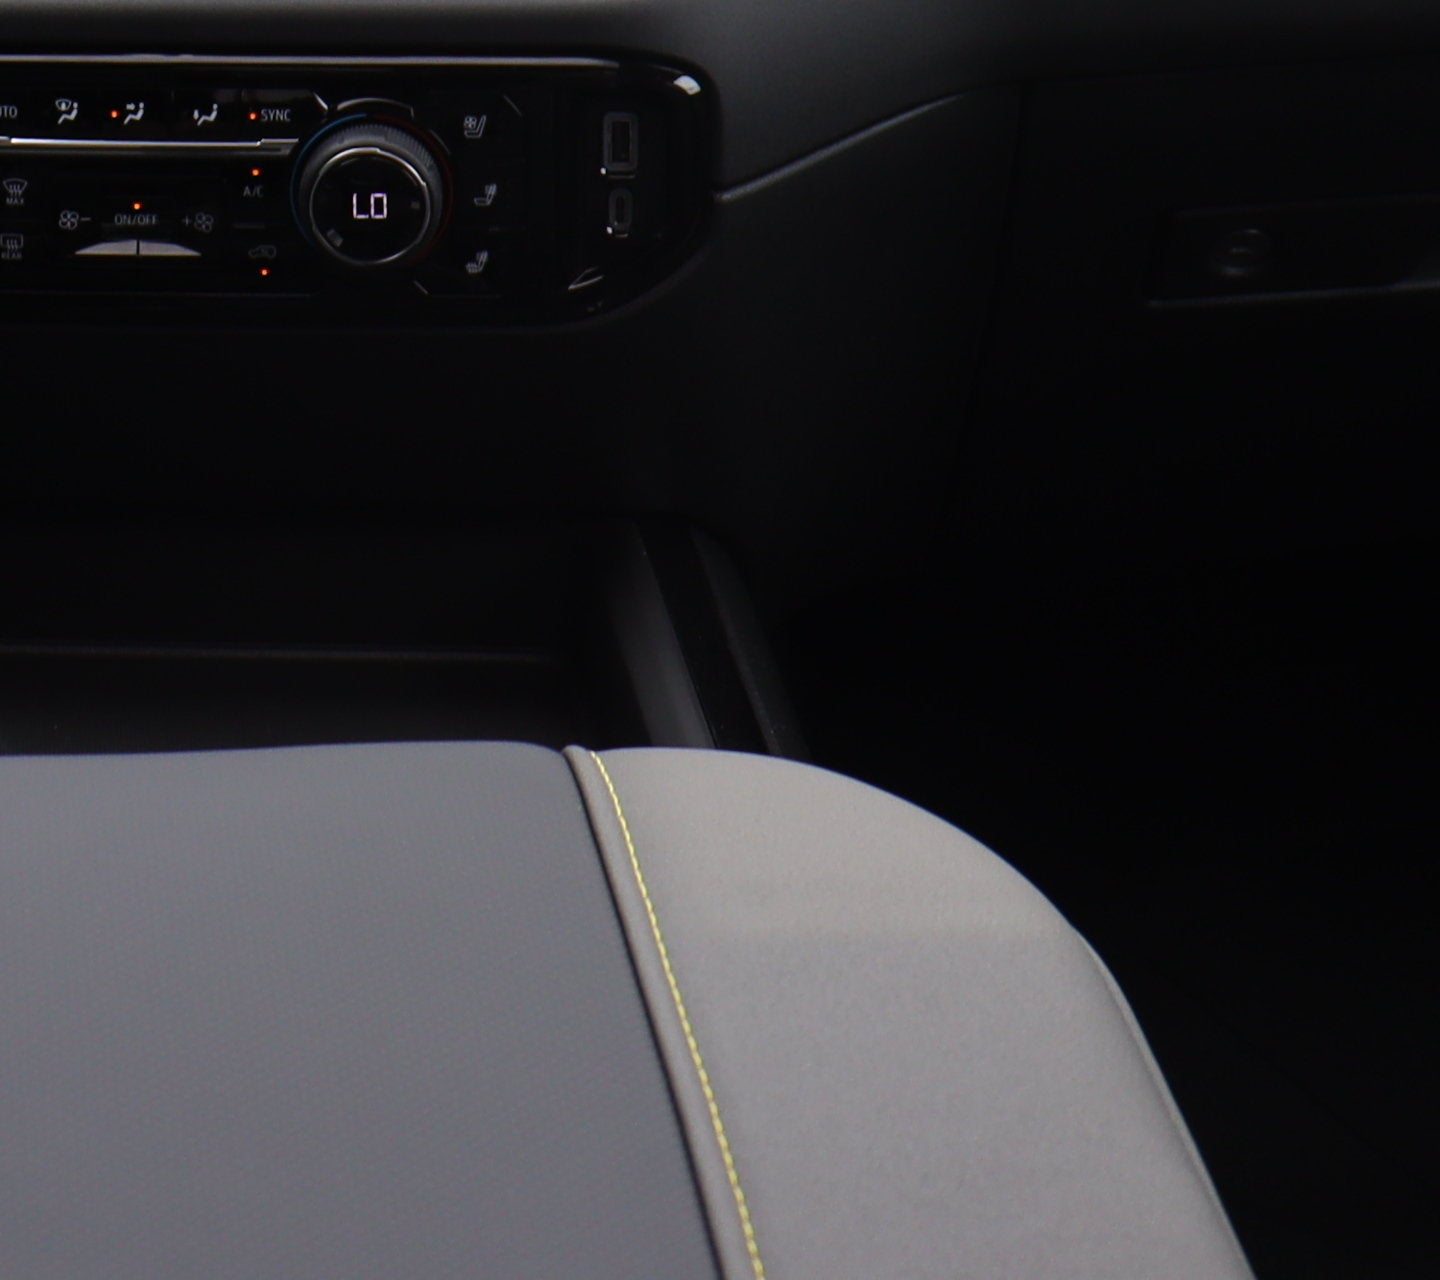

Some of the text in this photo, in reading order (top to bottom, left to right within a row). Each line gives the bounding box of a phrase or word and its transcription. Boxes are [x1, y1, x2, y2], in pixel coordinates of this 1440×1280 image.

[260, 108, 292, 123] SYNC
[242, 185, 264, 198] A/C
[351, 192, 388, 220] LO
[114, 213, 159, 226] ON/OFF
